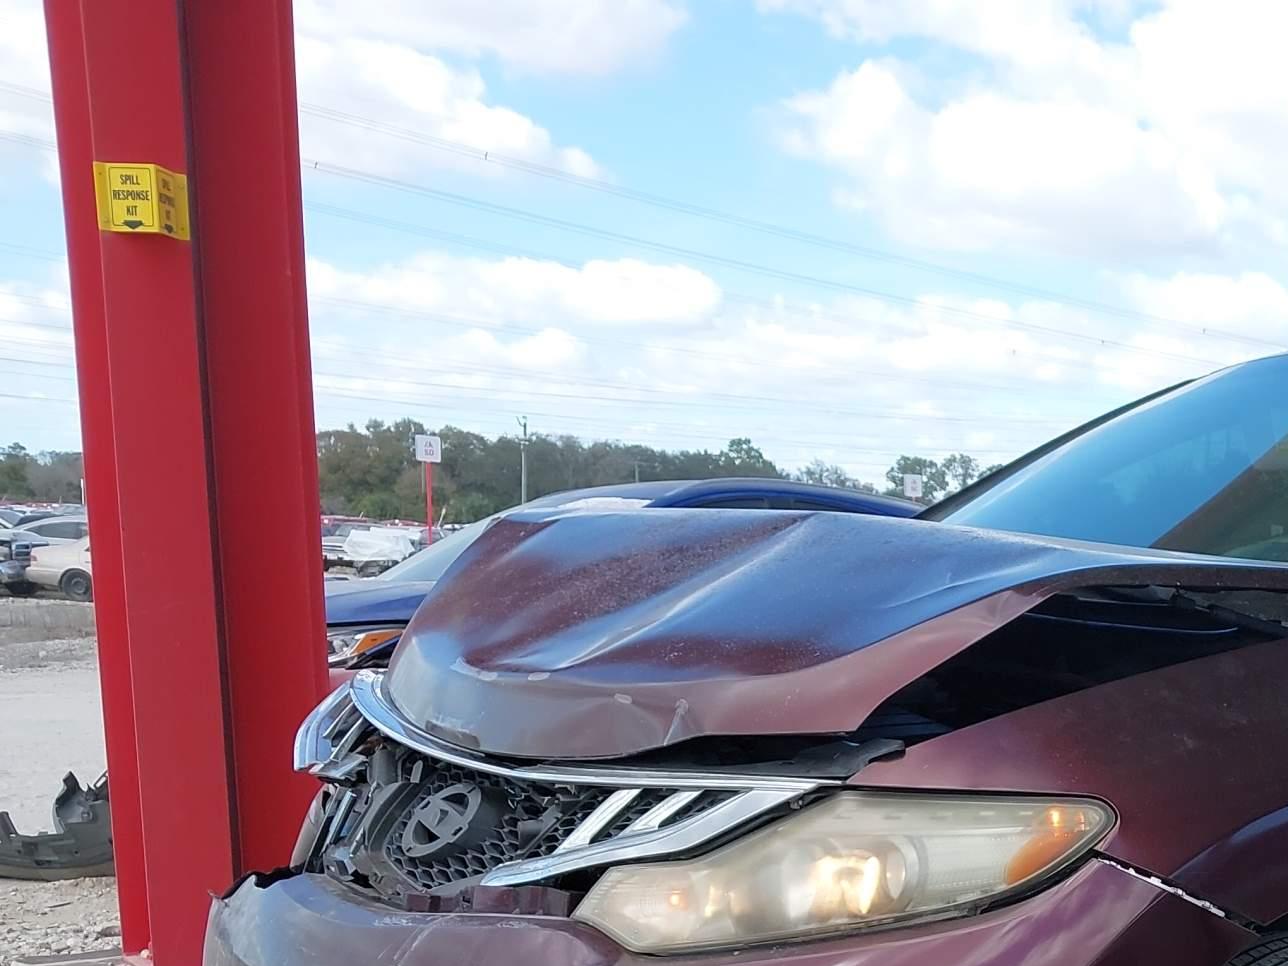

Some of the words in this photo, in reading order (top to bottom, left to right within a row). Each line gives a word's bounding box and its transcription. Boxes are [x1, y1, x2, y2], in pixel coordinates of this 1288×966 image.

[119, 174, 140, 185] SPILL
[112, 189, 150, 201] RESPONSE
[126, 205, 138, 216] KIT
